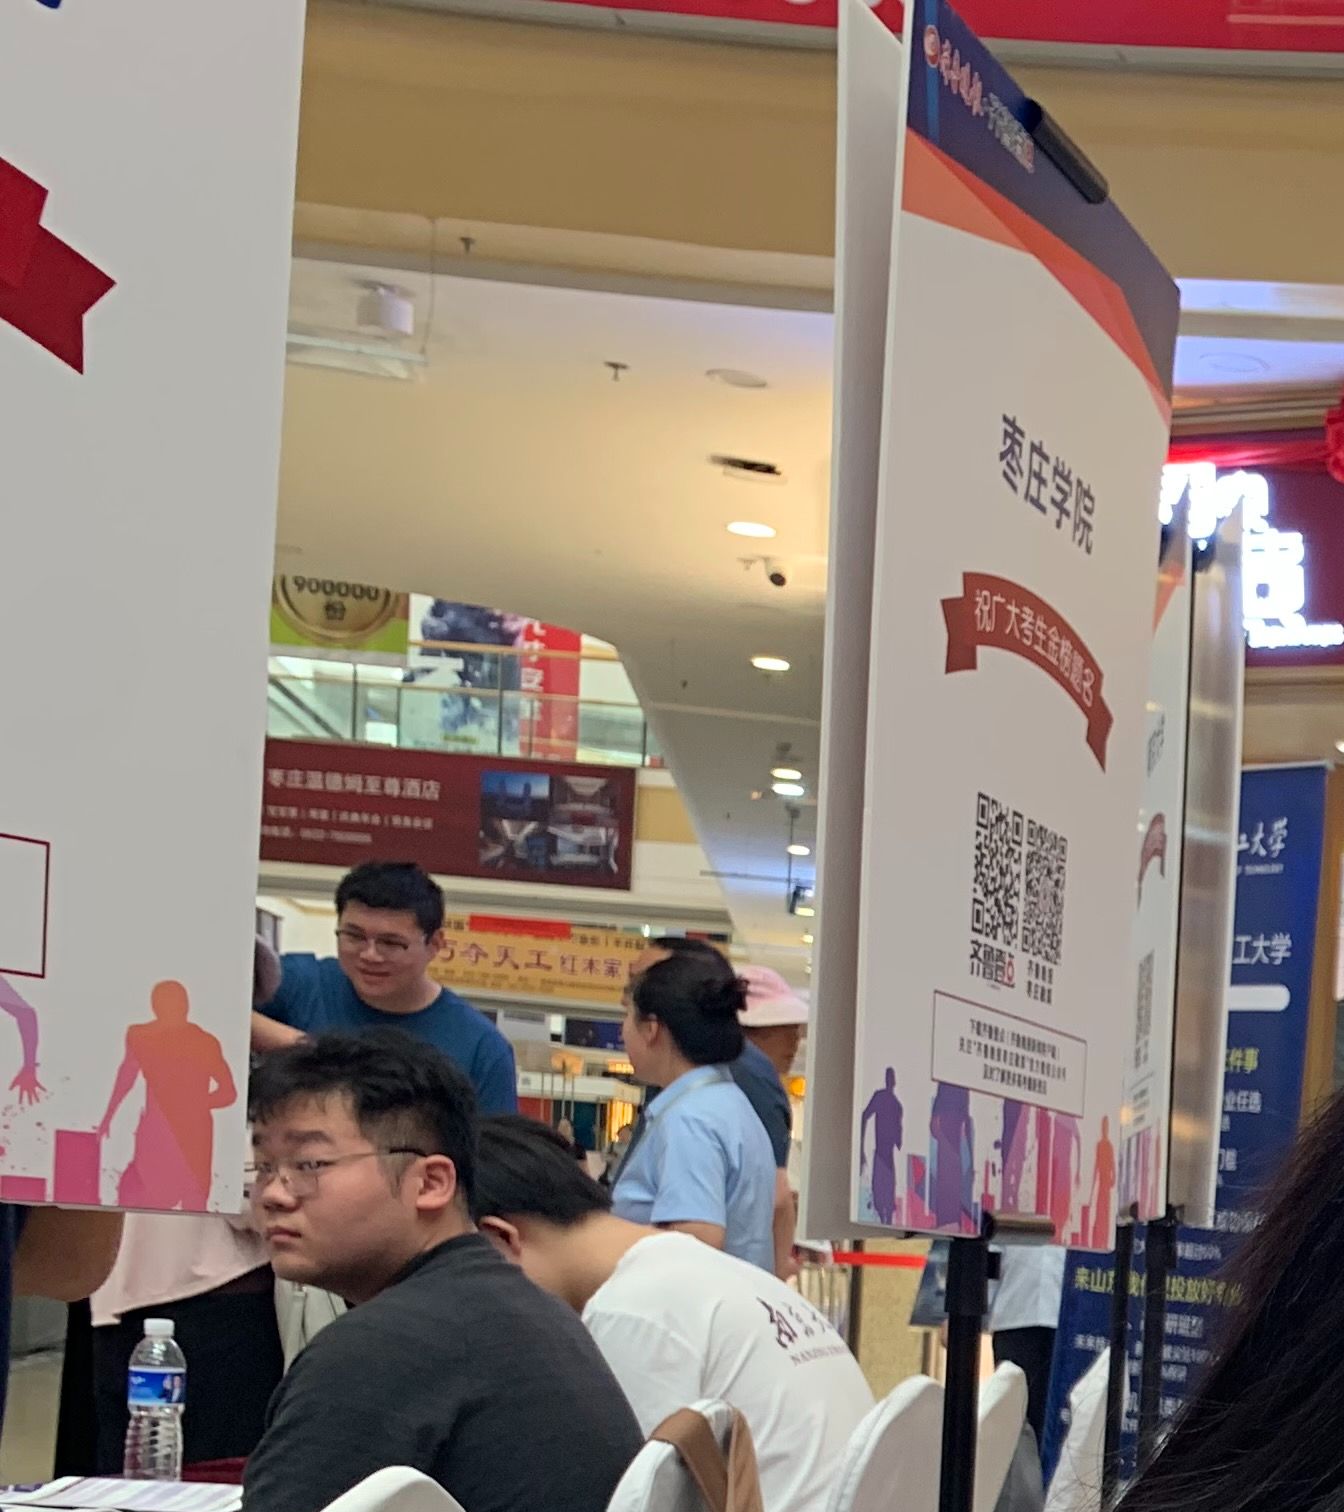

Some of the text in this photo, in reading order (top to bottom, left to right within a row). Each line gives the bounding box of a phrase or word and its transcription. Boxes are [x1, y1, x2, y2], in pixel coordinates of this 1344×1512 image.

[999, 413, 1096, 556] 枣庄学院
[974, 588, 1096, 708] 祝广大考生金榜题名
